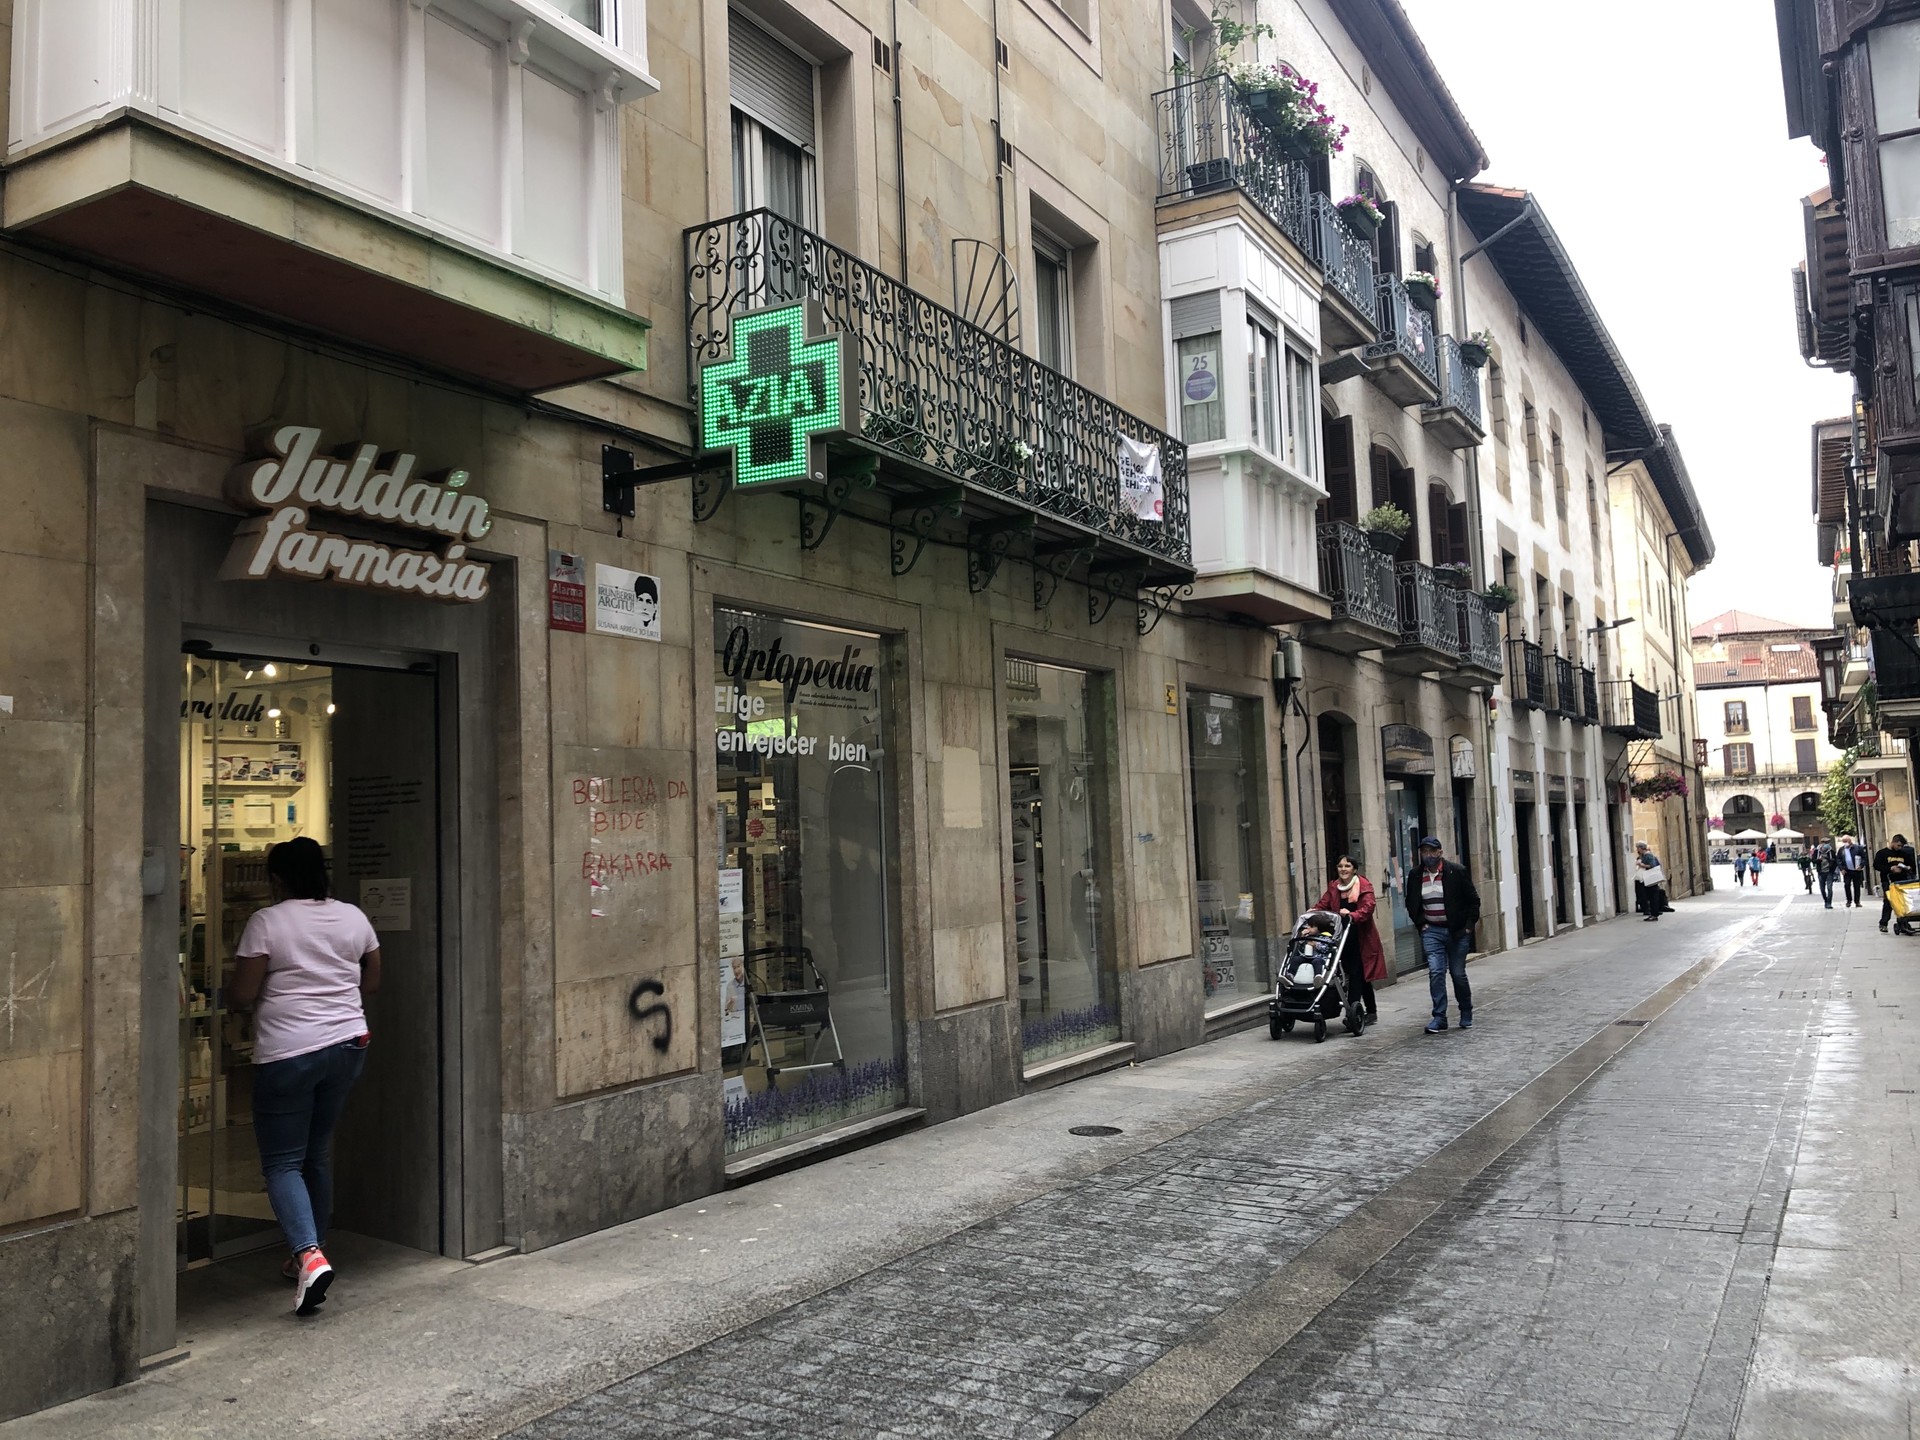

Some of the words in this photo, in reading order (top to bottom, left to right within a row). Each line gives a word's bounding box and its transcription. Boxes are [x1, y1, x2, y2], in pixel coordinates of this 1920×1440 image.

[1192, 355, 1208, 371] 25
[251, 425, 492, 538] Juldain
[248, 506, 487, 600] farmazia
[552, 582, 583, 598] Alarma
[723, 626, 874, 703] Ortopedia
[714, 686, 765, 721] Elige
[717, 727, 817, 759] envejecer
[828, 735, 866, 762] bien
[668, 780, 690, 800] DA
[594, 811, 648, 836] BIDE
[582, 851, 672, 881] BAKARRA
